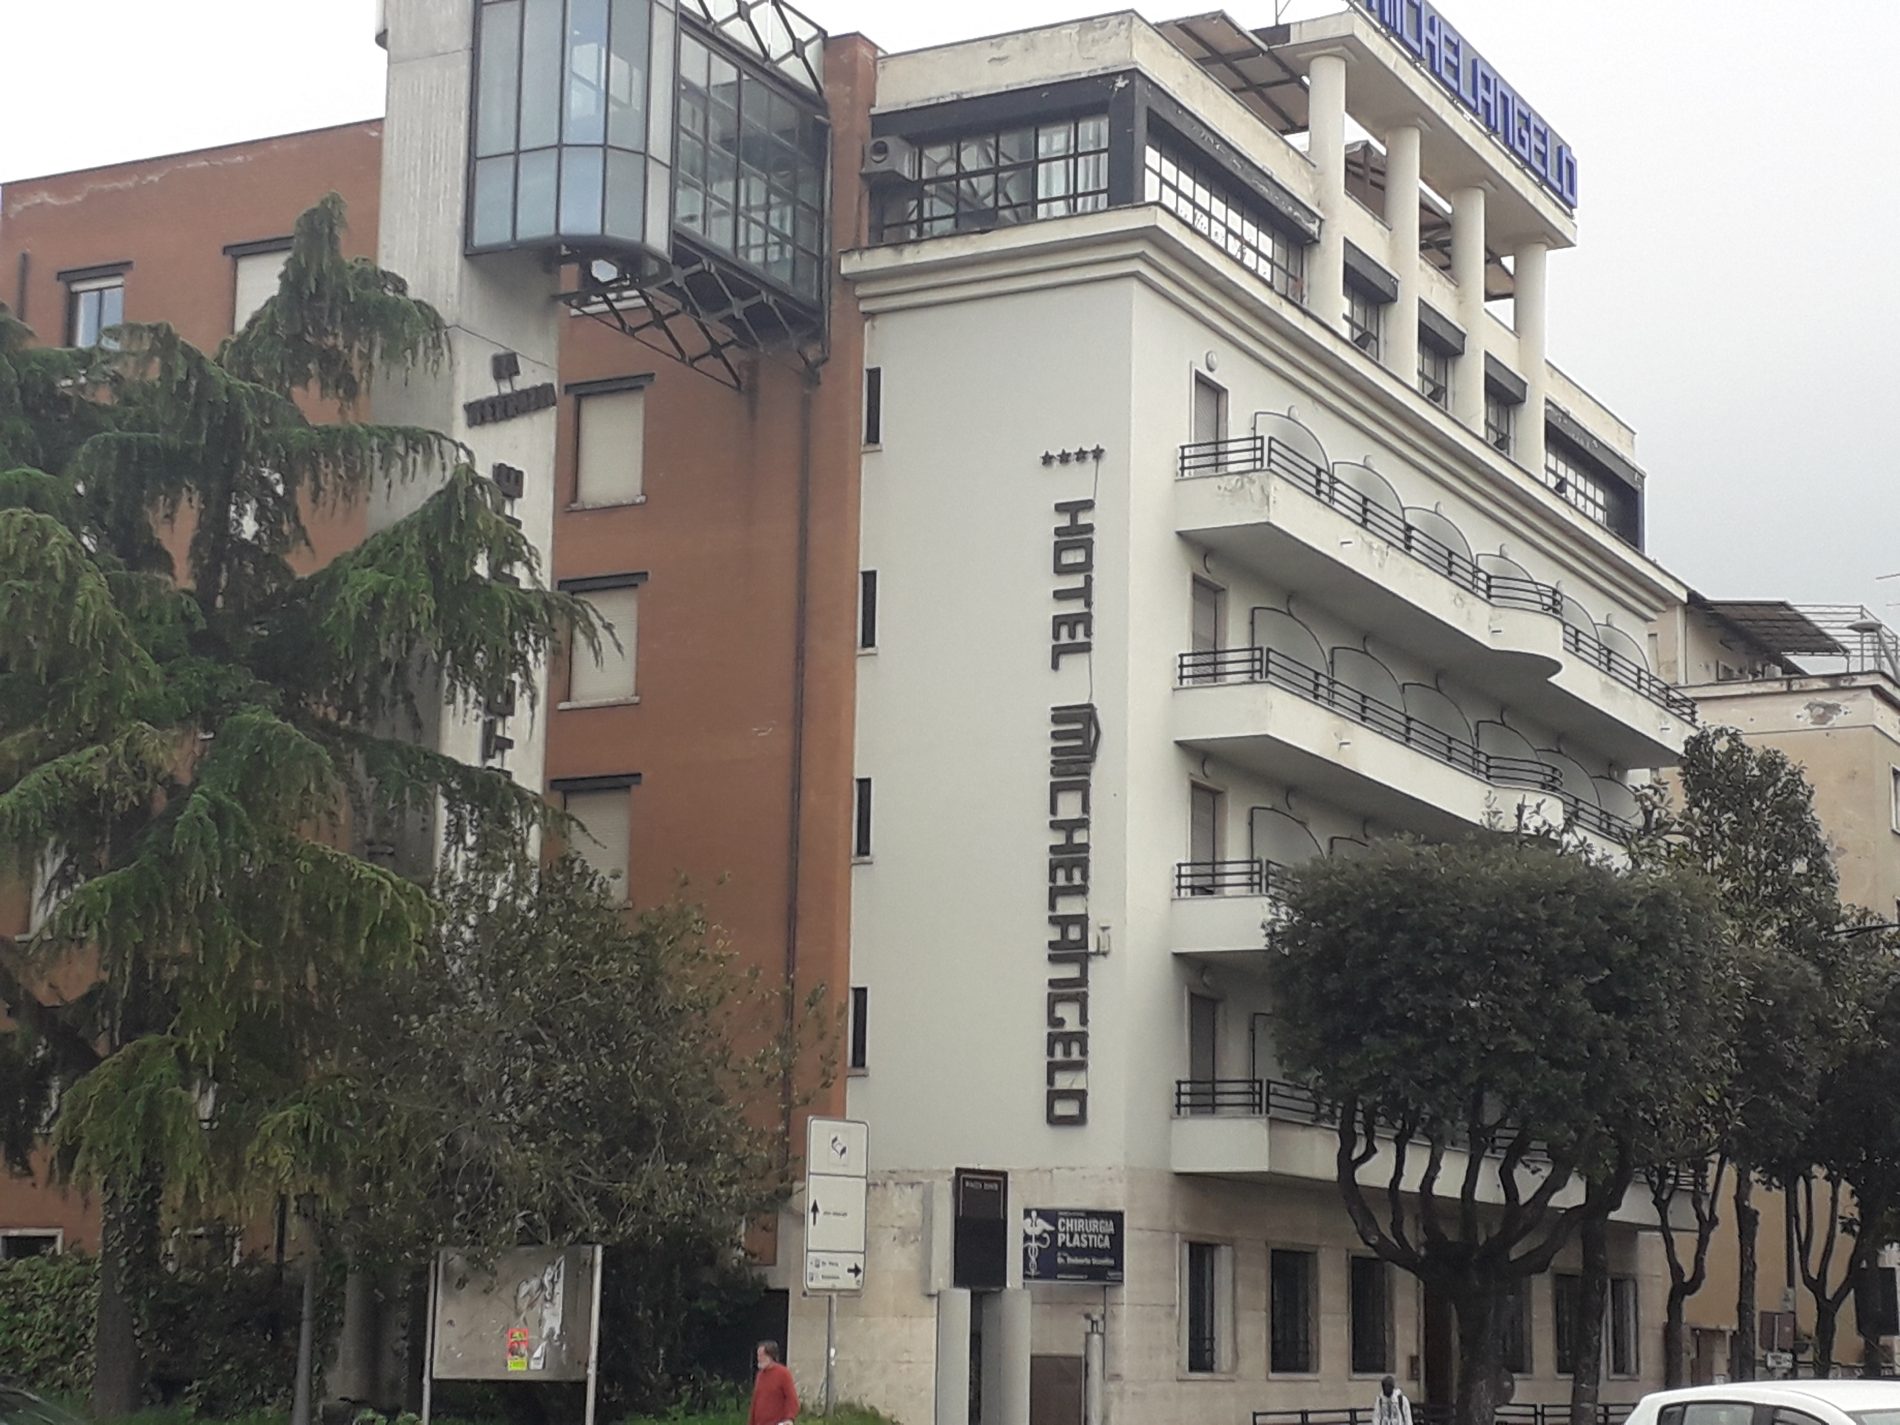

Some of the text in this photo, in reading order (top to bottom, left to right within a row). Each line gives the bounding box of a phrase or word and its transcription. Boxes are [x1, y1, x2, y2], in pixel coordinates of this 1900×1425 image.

[1365, 0, 1578, 209] ICHELANGELO
[1046, 499, 1101, 1126] HOTEL MICHELANGELO
[1057, 1217, 1115, 1235] CHIRURGIA
[1057, 1232, 1111, 1249] PLASTICA
